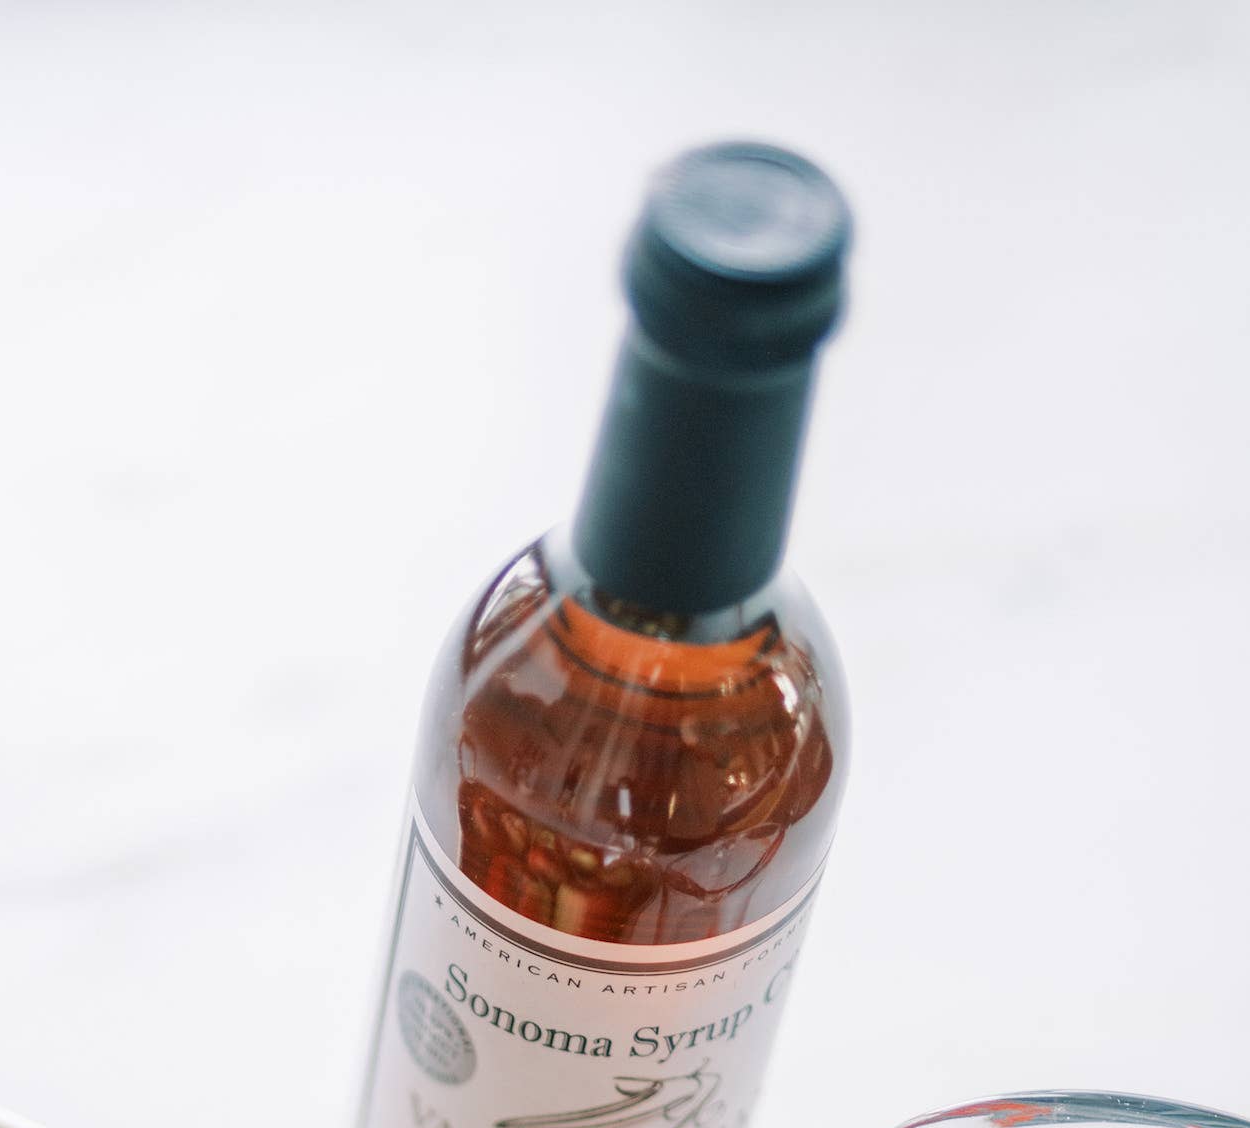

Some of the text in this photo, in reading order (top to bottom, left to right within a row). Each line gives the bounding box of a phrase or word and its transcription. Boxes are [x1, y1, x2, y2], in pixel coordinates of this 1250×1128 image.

[451, 914, 806, 996] AMERICAN ARTISAN FORM
[445, 963, 613, 1058] Sonoma
[629, 1004, 754, 1064] Syrup
[764, 948, 802, 1004] C
